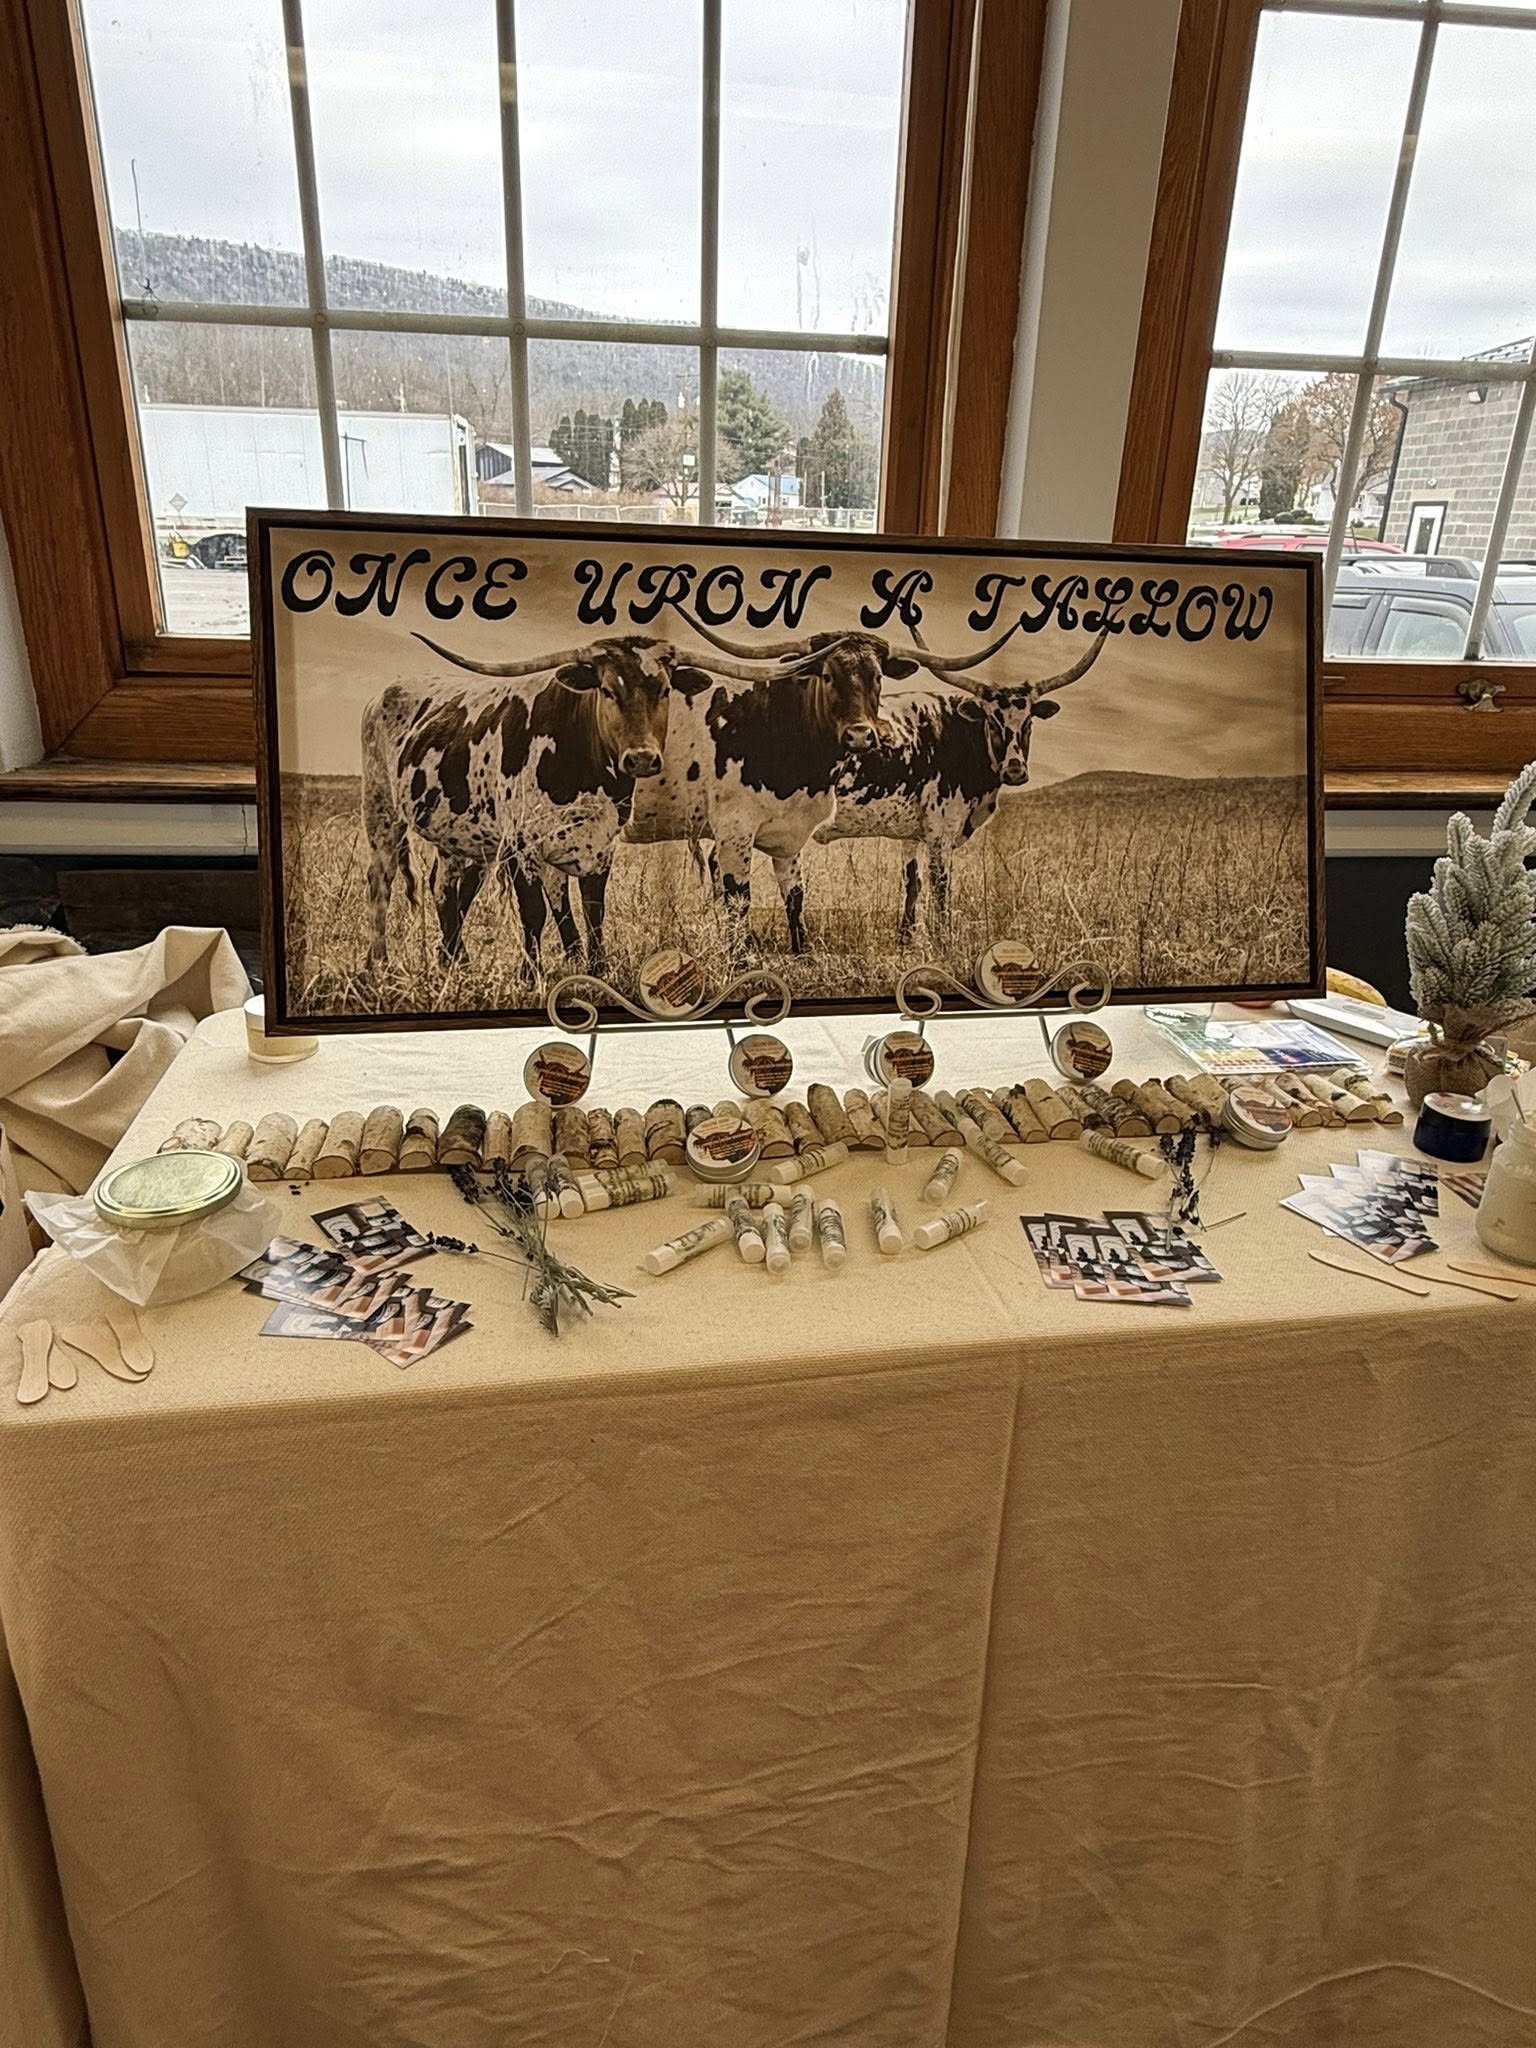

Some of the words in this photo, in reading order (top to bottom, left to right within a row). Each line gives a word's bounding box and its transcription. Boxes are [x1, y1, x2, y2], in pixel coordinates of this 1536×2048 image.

[281, 548, 528, 620] ONCE
[574, 559, 832, 629] UPON
[860, 569, 934, 629] A
[968, 573, 1274, 643] TALLOW
